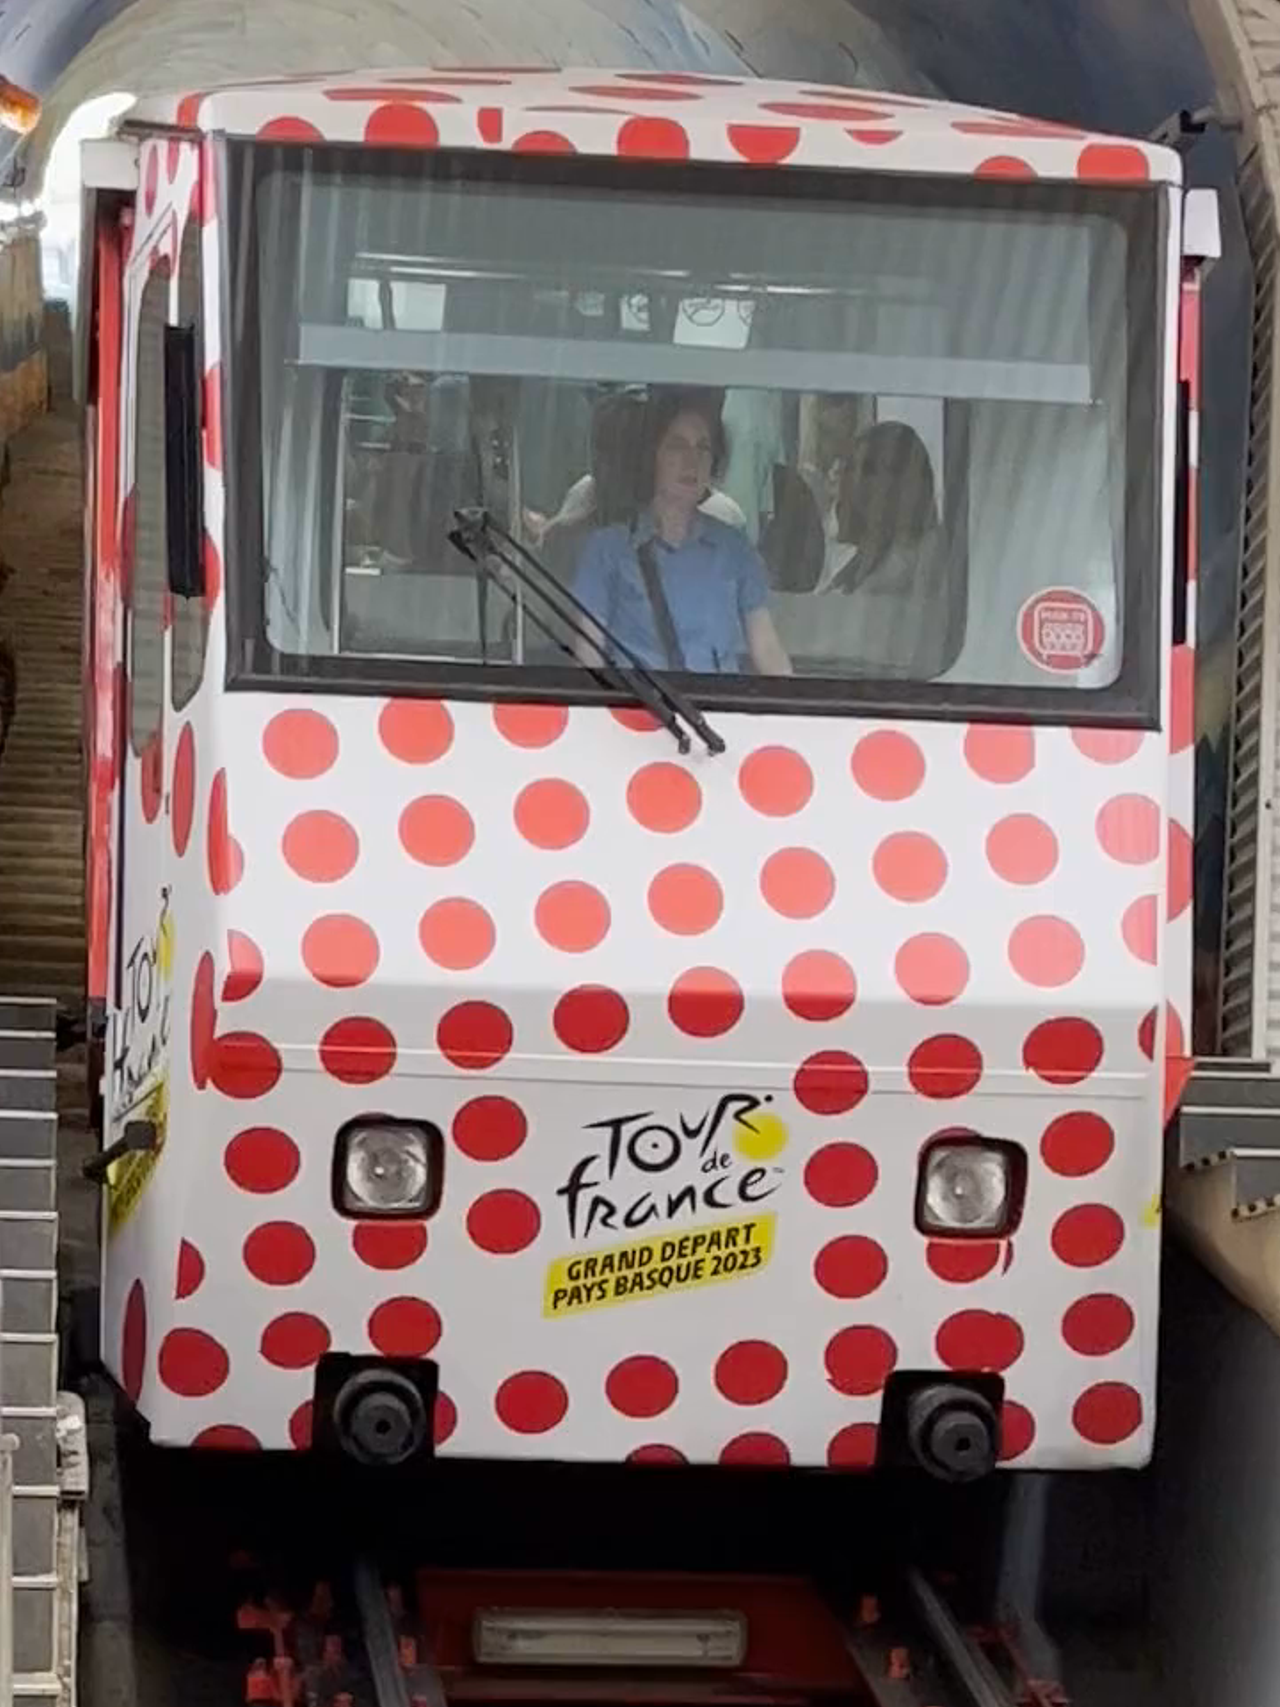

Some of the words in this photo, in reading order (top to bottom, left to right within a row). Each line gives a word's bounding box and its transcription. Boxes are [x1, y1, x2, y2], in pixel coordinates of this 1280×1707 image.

[700, 1148, 733, 1174] de
[551, 1280, 610, 1310] PAYS
[613, 1257, 706, 1297] BASQUE
[709, 1246, 762, 1277] 2023
[566, 1245, 654, 1281] GRAND
